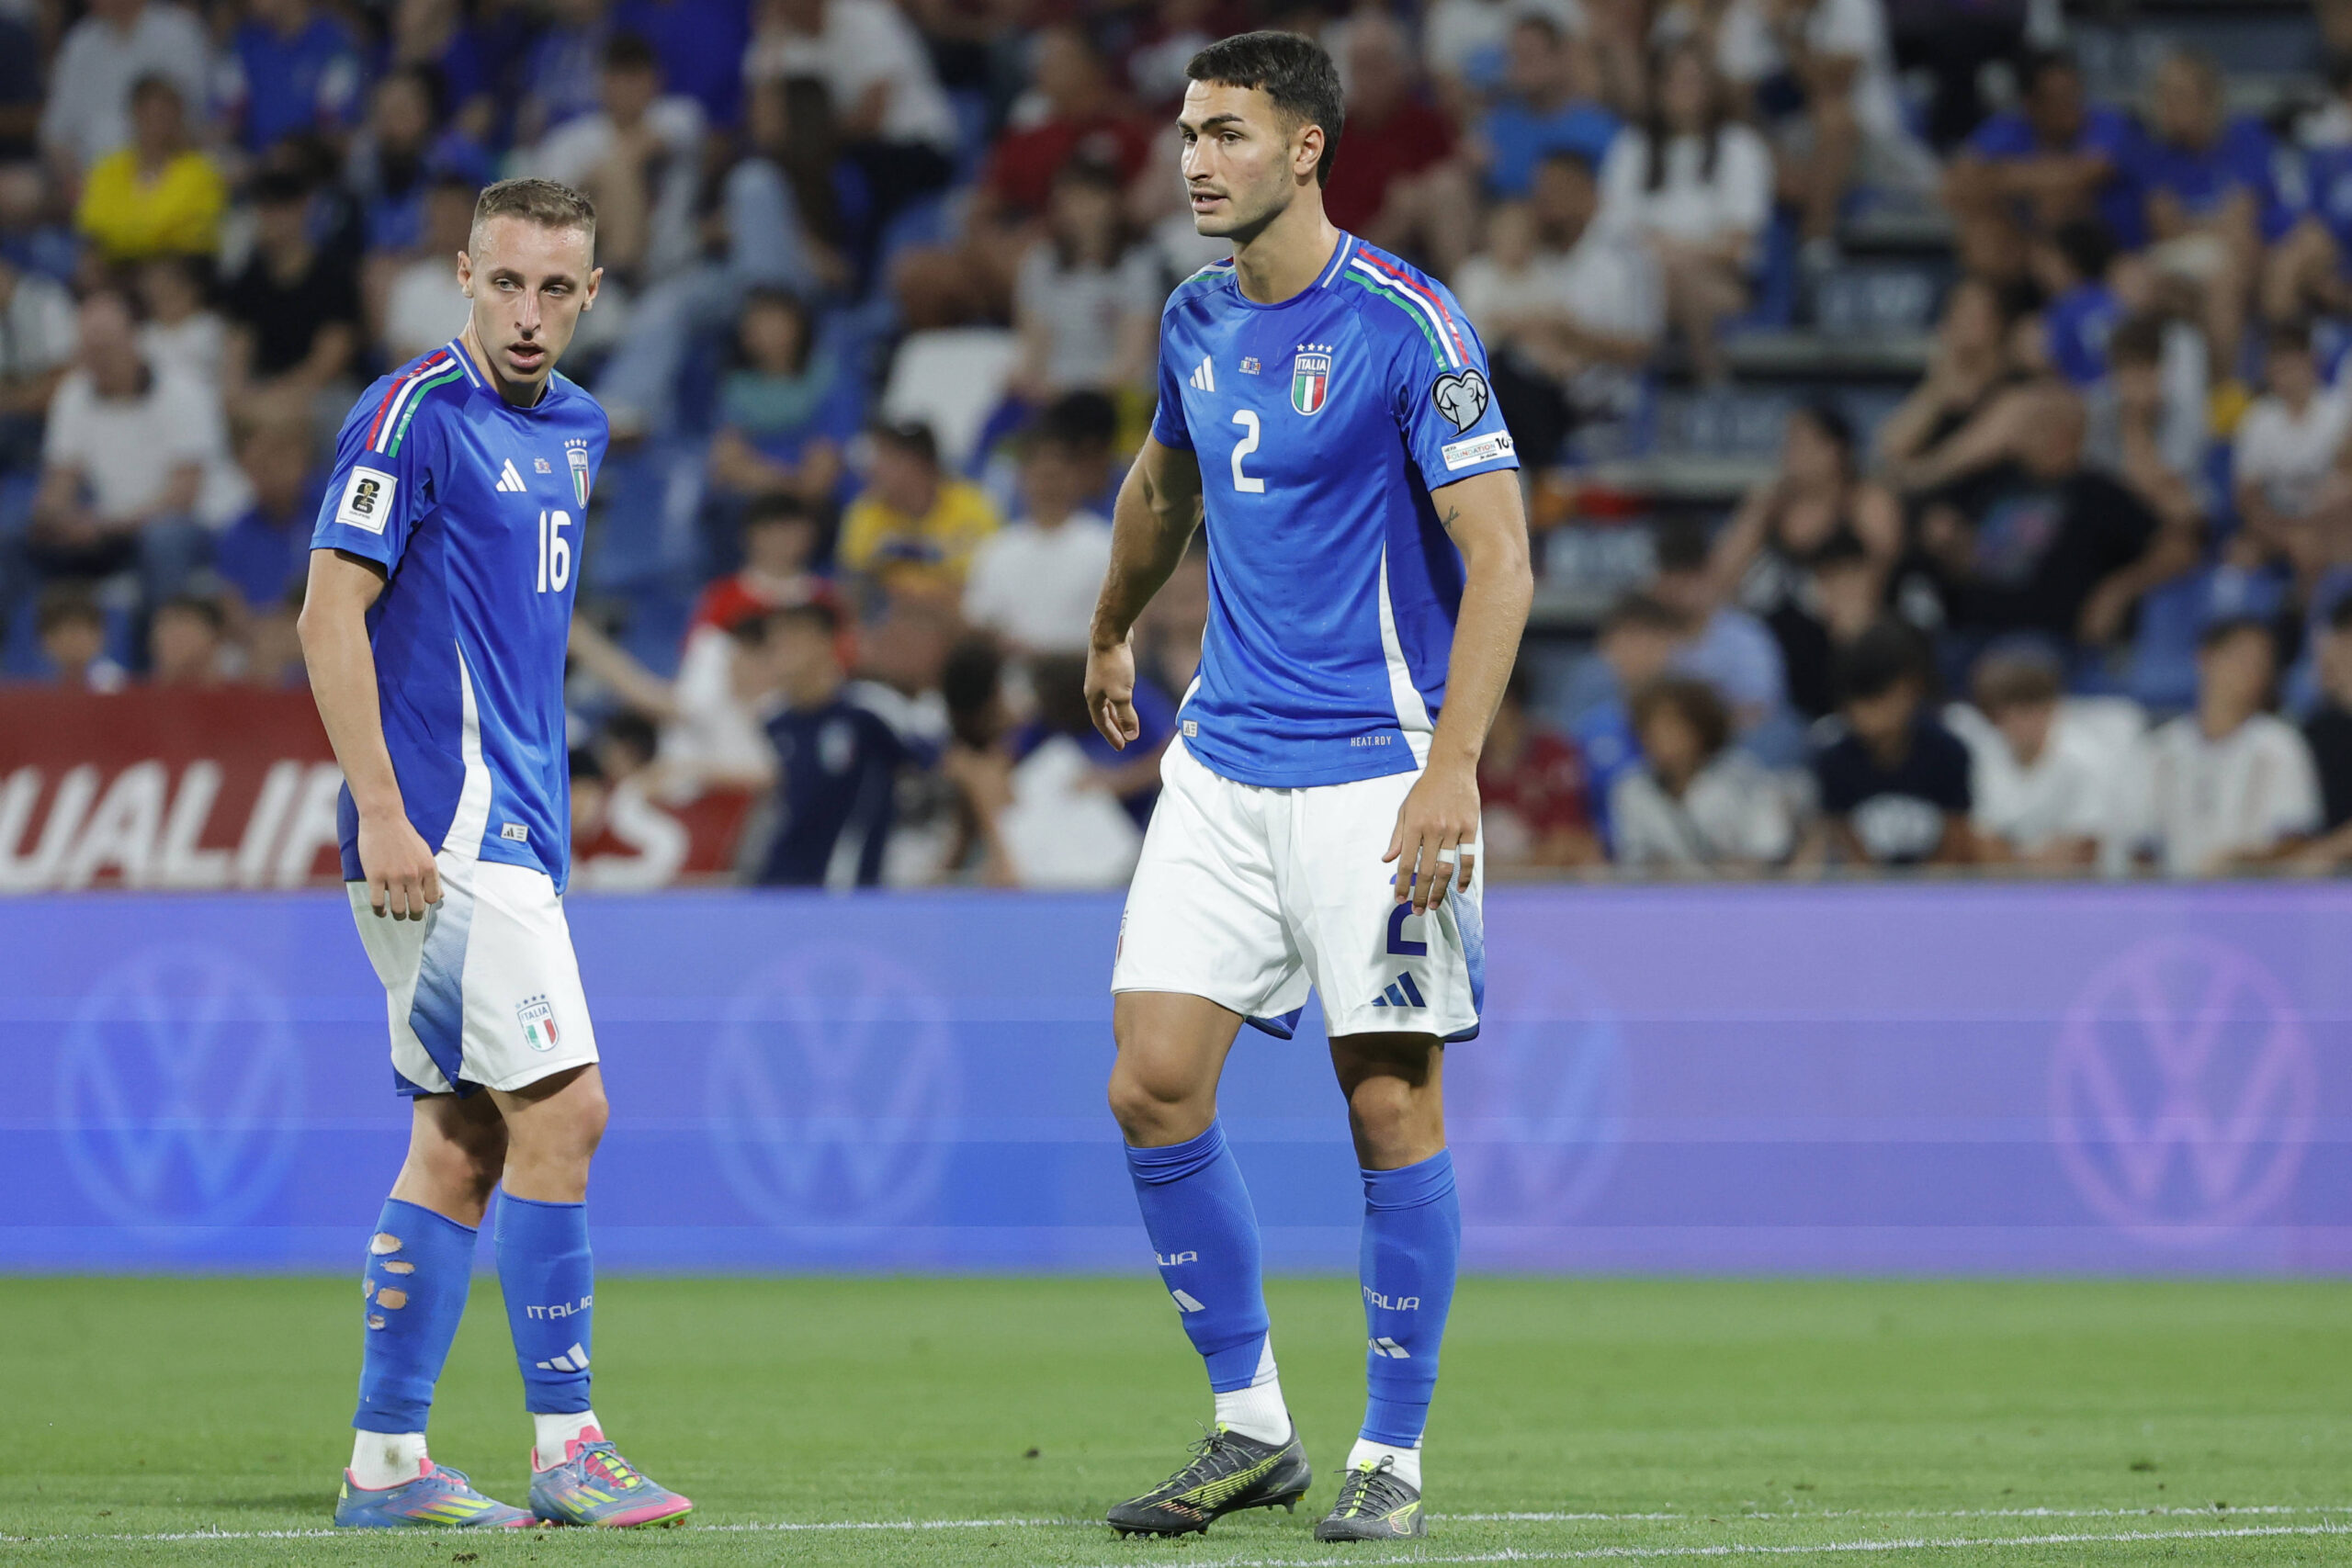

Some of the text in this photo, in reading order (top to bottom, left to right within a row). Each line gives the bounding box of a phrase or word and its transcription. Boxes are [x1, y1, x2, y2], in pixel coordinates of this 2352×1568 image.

[1297, 358, 1327, 371] ITALIA
[1231, 409, 1265, 493] 2
[537, 510, 572, 593] 16
[521, 1006, 548, 1021] ITALIA
[1154, 1250, 1198, 1266] LIA
[526, 1294, 593, 1320] ITALIA
[1363, 1285, 1420, 1311] ITALIA
